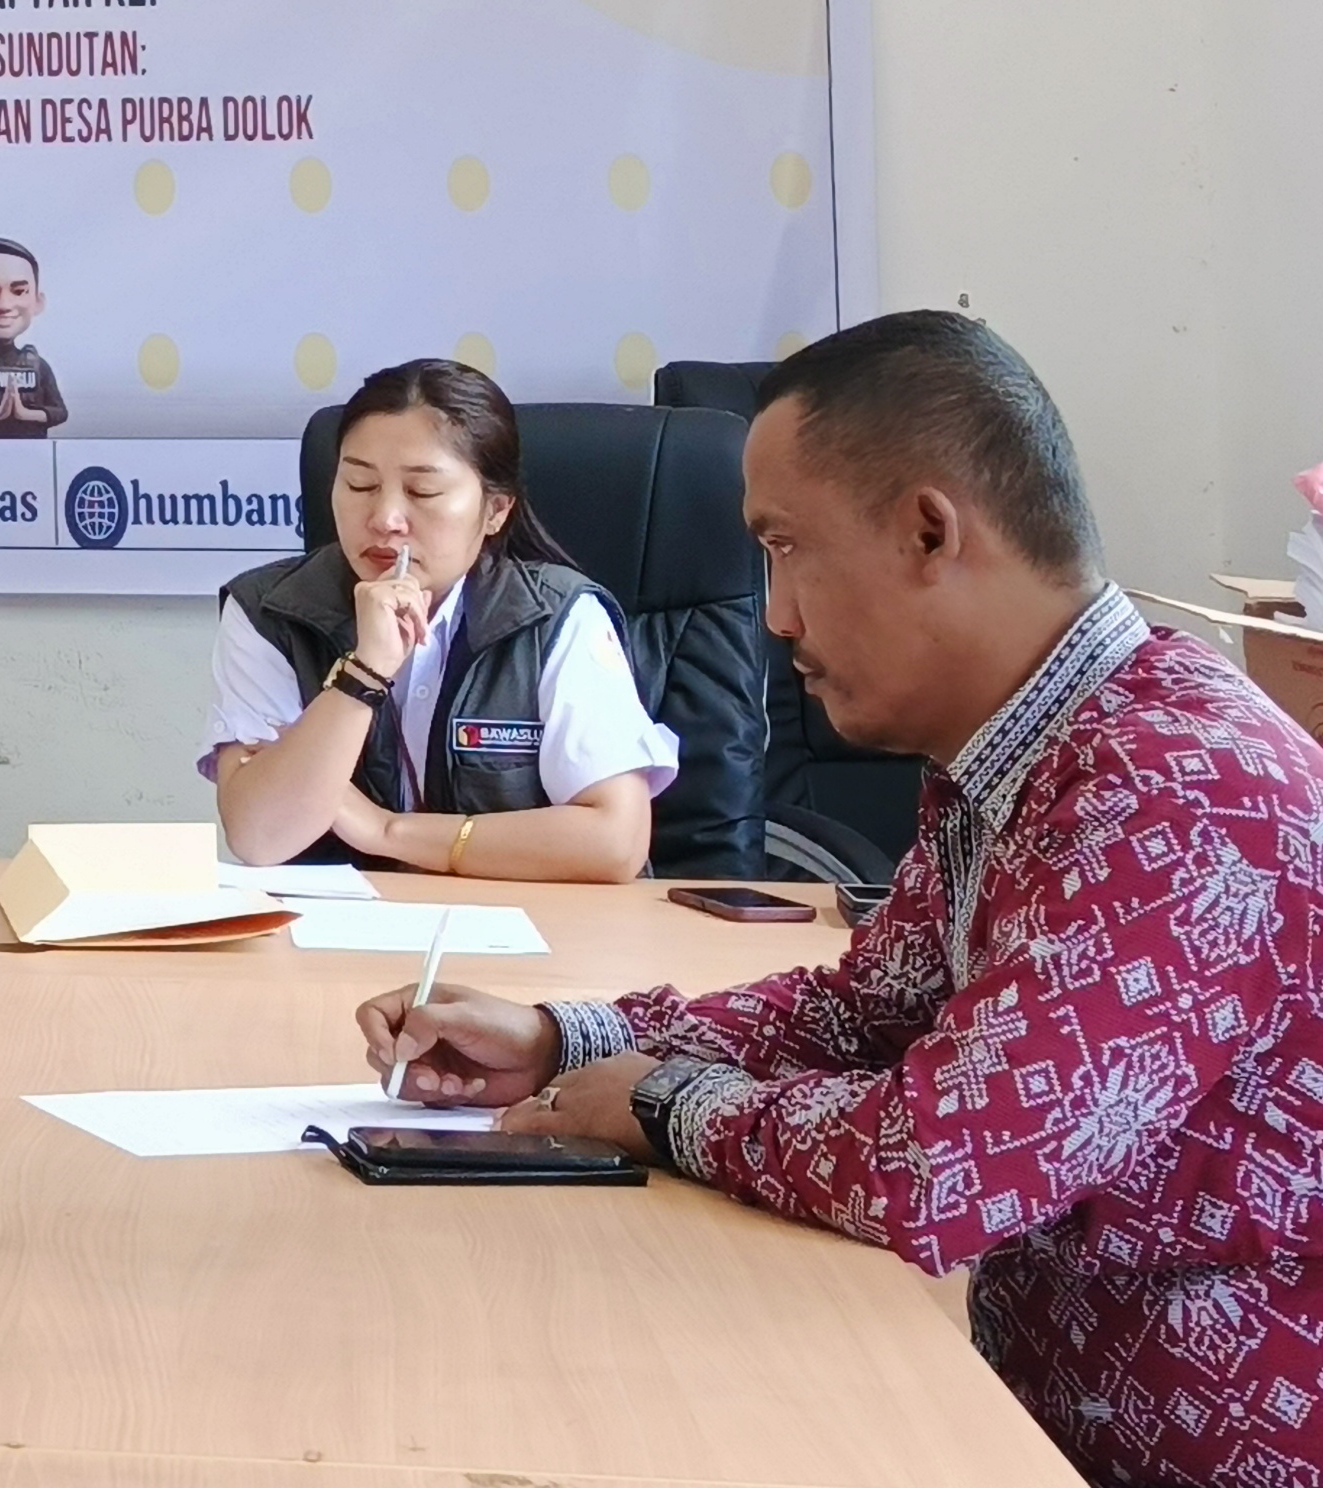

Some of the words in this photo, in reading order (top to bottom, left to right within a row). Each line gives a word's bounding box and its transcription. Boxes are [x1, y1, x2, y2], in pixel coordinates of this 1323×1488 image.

[41, 97, 112, 144] DESA
[121, 95, 214, 143] PURBA
[223, 94, 314, 141] DOLOK
